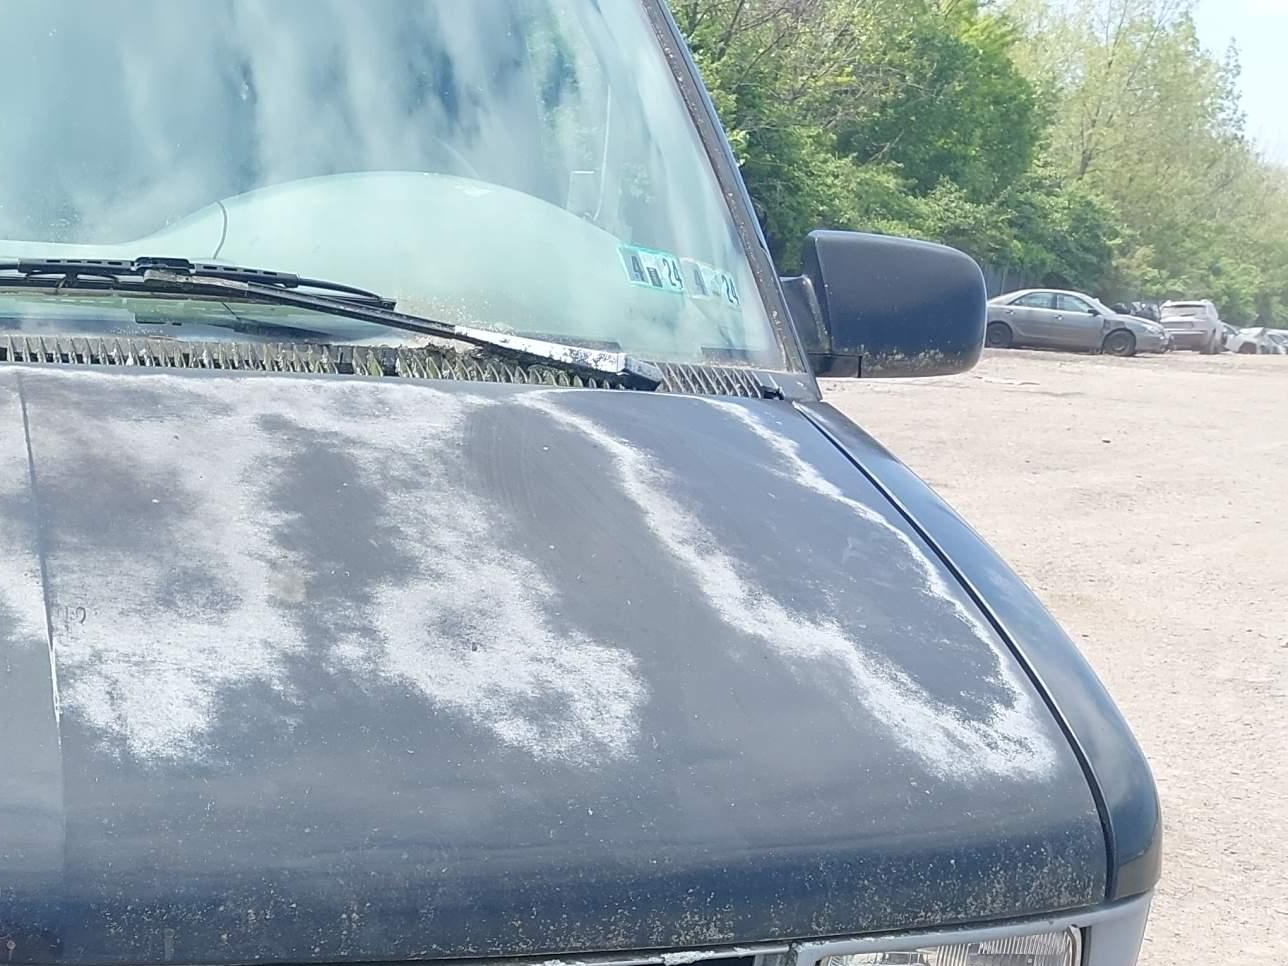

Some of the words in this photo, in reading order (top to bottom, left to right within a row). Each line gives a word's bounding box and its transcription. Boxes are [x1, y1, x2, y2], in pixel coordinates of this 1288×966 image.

[631, 255, 646, 282] 4
[662, 257, 684, 289] 24
[721, 273, 741, 307] 24
